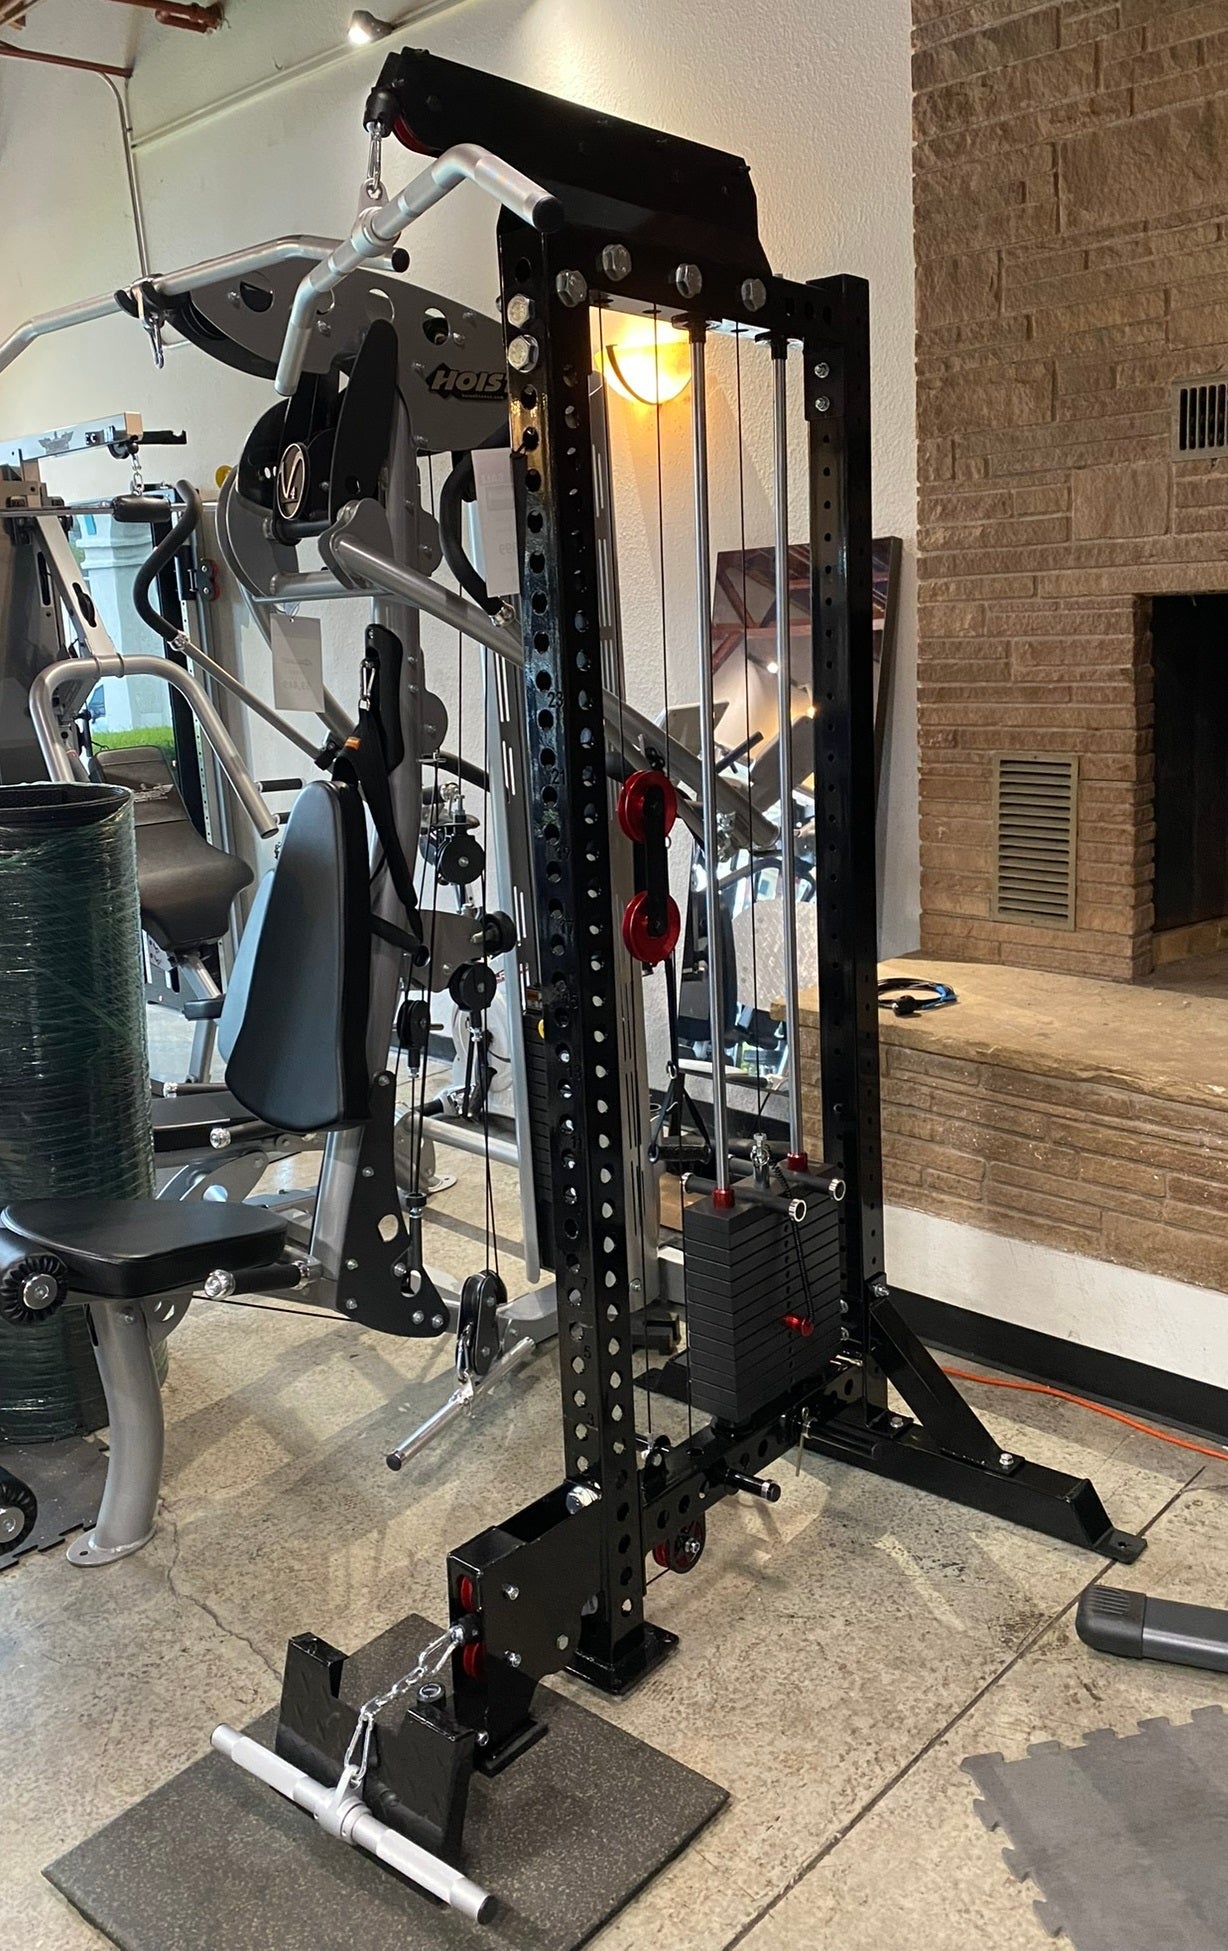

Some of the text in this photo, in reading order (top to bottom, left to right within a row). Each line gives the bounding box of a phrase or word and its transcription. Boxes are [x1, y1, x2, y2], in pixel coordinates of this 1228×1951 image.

[431, 370, 508, 392] HOIS
[547, 691, 563, 708] 23
[550, 768, 565, 785] 21
[583, 1345, 592, 1359] 5
